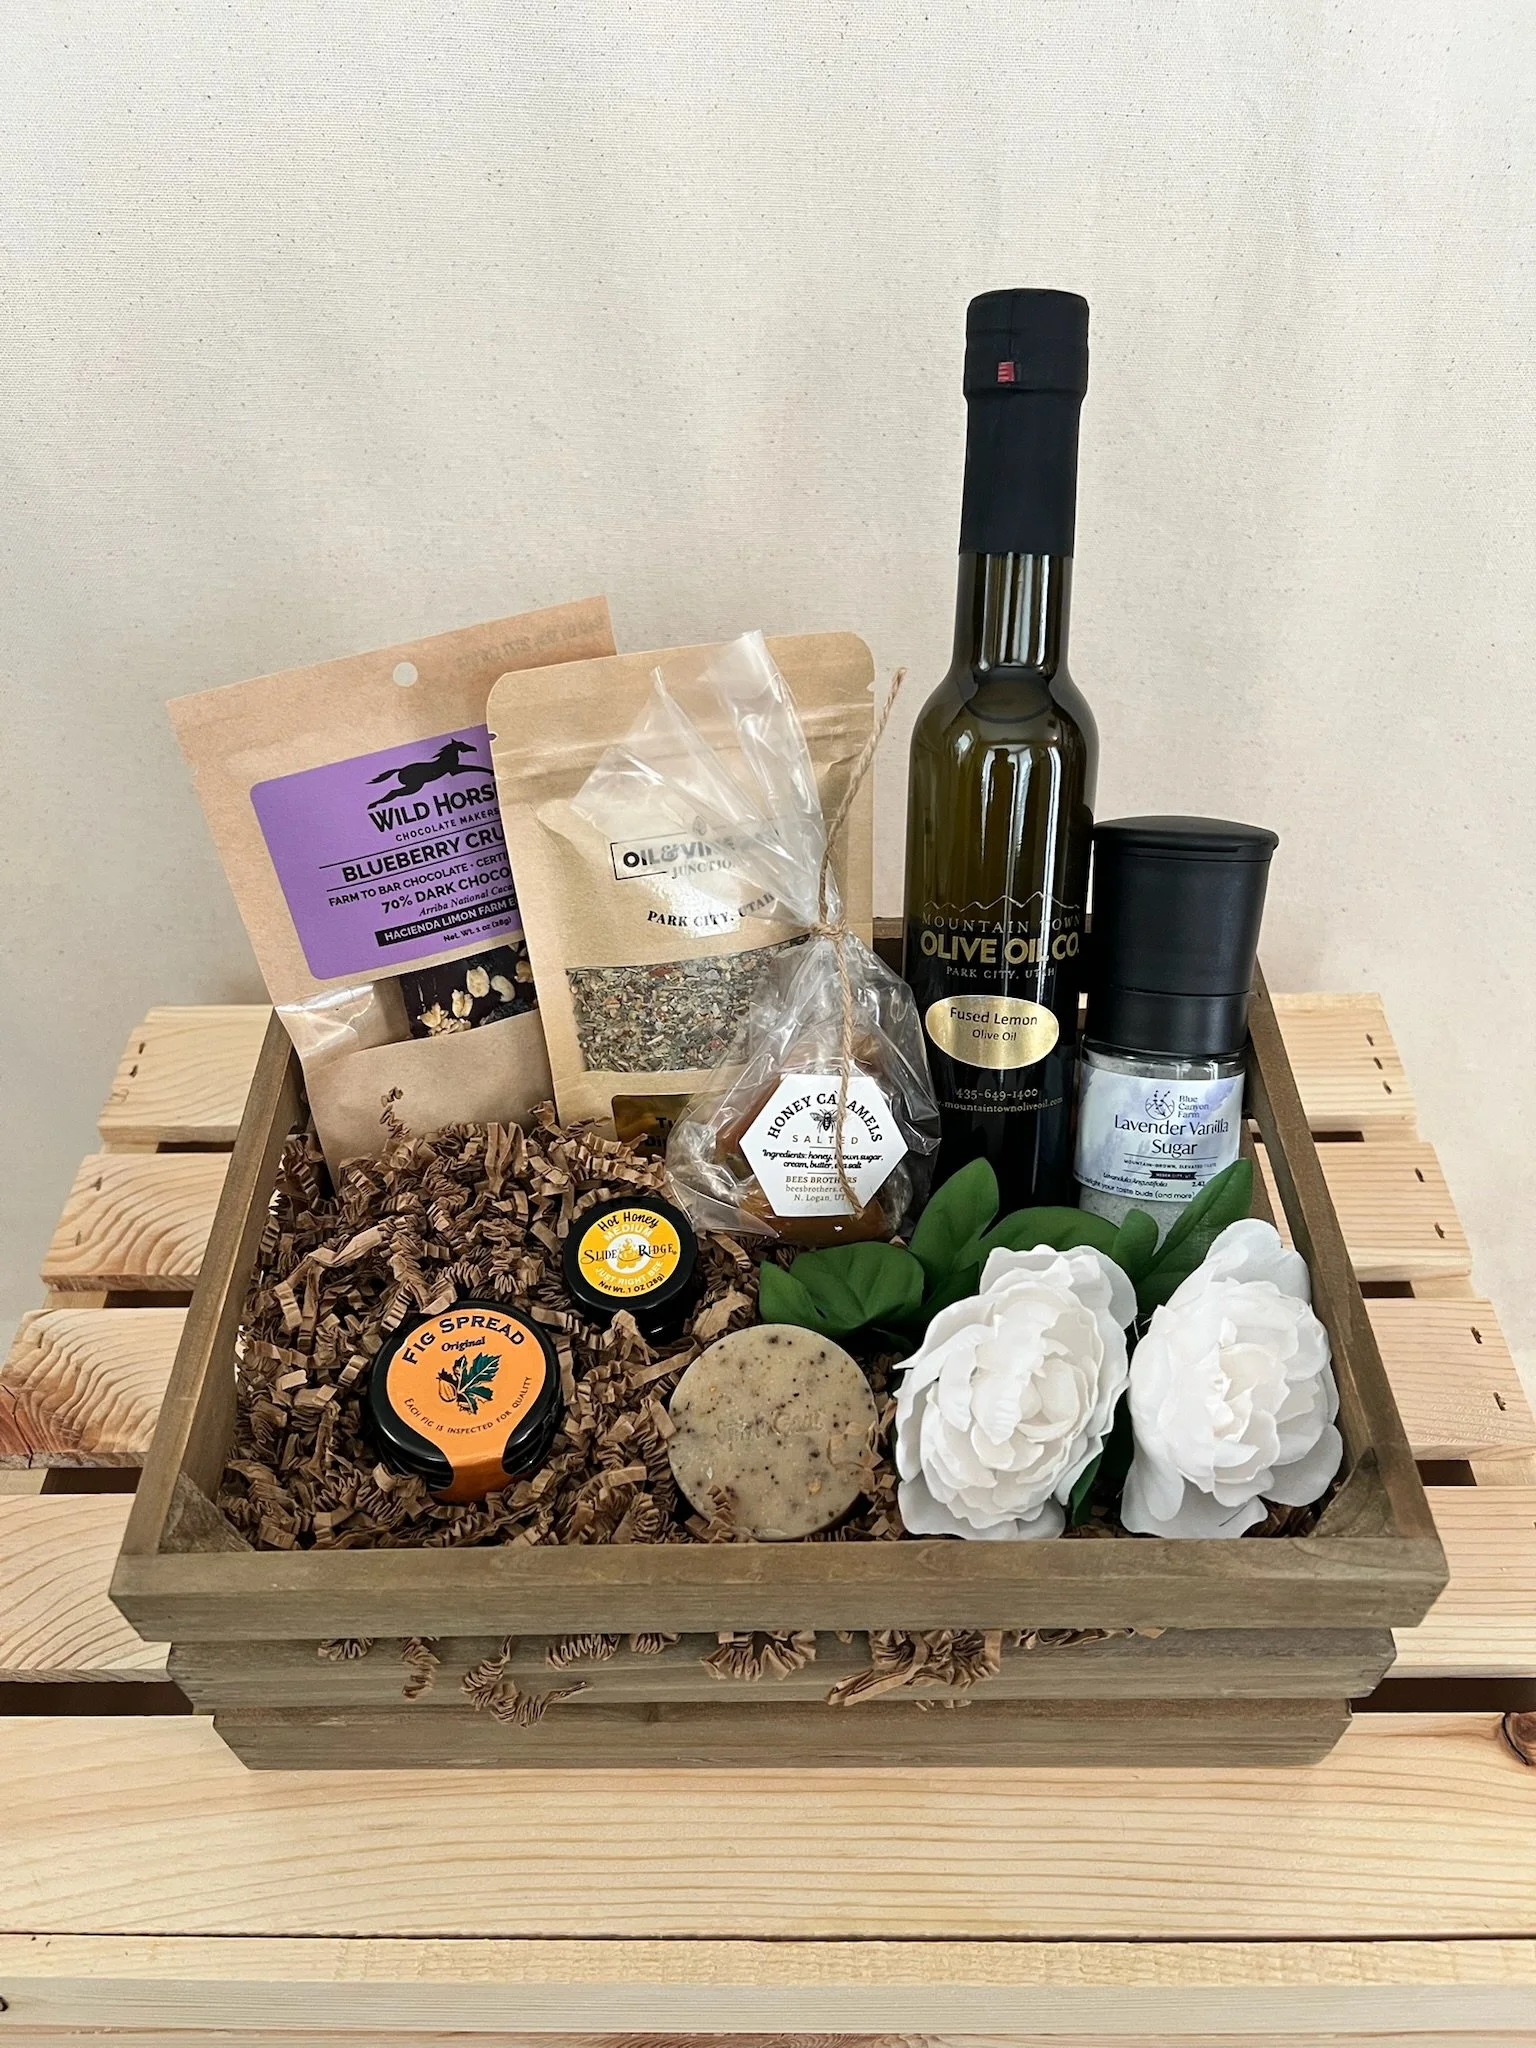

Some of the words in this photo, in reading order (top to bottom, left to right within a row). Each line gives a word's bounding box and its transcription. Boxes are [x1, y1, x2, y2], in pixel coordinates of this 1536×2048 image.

[368, 802, 430, 833] WILD
[395, 819, 457, 842] CHOCOLATE
[460, 807, 500, 825] MAKERS
[342, 837, 460, 883] BLUEBERRY
[672, 859, 736, 879] JUNCTIO
[328, 890, 360, 907] FARM
[360, 888, 377, 900] TO
[378, 882, 401, 896] BAR
[403, 864, 469, 889] CHOCOLATE
[381, 893, 413, 914] 70%
[414, 881, 456, 903] DARK
[458, 866, 511, 890] CHOCO
[419, 903, 448, 917] Arriba
[450, 889, 489, 908] National
[647, 910, 688, 927] PARK
[738, 892, 775, 918] UTAH
[384, 920, 441, 941] HACIENDA
[442, 908, 477, 927] LIMON
[478, 901, 507, 916] FARM
[922, 911, 1030, 934] MOUNTAIN
[920, 930, 998, 964] OLIVE
[1004, 937, 1050, 965] OIL
[946, 966, 977, 979] PARK
[949, 1006, 990, 1024] Fused
[993, 1012, 1038, 1026] Lemon
[972, 1029, 999, 1041] Olive
[1002, 1031, 1017, 1041] Oil
[955, 1087, 1039, 1102] 435-649-1400
[1179, 1095, 1198, 1104] Blue
[768, 1095, 812, 1139] HONEY
[816, 1093, 883, 1143] CAAMELS
[1178, 1103, 1209, 1112] Canyon
[1178, 1111, 1200, 1119] Farm
[1114, 1114, 1186, 1135] Lavender
[1189, 1118, 1229, 1135] Vanilla
[792, 1134, 859, 1146] SALTED
[1151, 1138, 1198, 1159] Sugar
[762, 1149, 807, 1161] Ingredients:
[834, 1153, 860, 1161] own
[848, 1161, 862, 1169] salt
[785, 1176, 808, 1184] BEES
[810, 1176, 857, 1184] BROTHRS
[785, 1184, 856, 1193] beesbrothers.cm
[1155, 1190, 1172, 1199] (and
[597, 1216, 620, 1232] Hot
[623, 1211, 660, 1229] Honey
[603, 1223, 654, 1241] MEDIUM
[581, 1249, 618, 1264] SLIDE
[638, 1243, 674, 1258] RIDGE
[595, 1266, 617, 1284] JUST
[618, 1275, 647, 1285] RIGHT
[648, 1260, 664, 1278] BEE
[598, 1280, 612, 1291] Net
[646, 1273, 665, 1289] (28g)
[402, 1331, 436, 1365] FIG
[439, 1315, 525, 1346] SPREAD
[441, 1336, 486, 1352] Original
[404, 1397, 422, 1418] EACH
[421, 1416, 433, 1428] FIG
[435, 1424, 444, 1433] IS
[447, 1421, 494, 1434] INSPECTED
[496, 1410, 512, 1423] FOR
[512, 1376, 532, 1409] QUALITY
